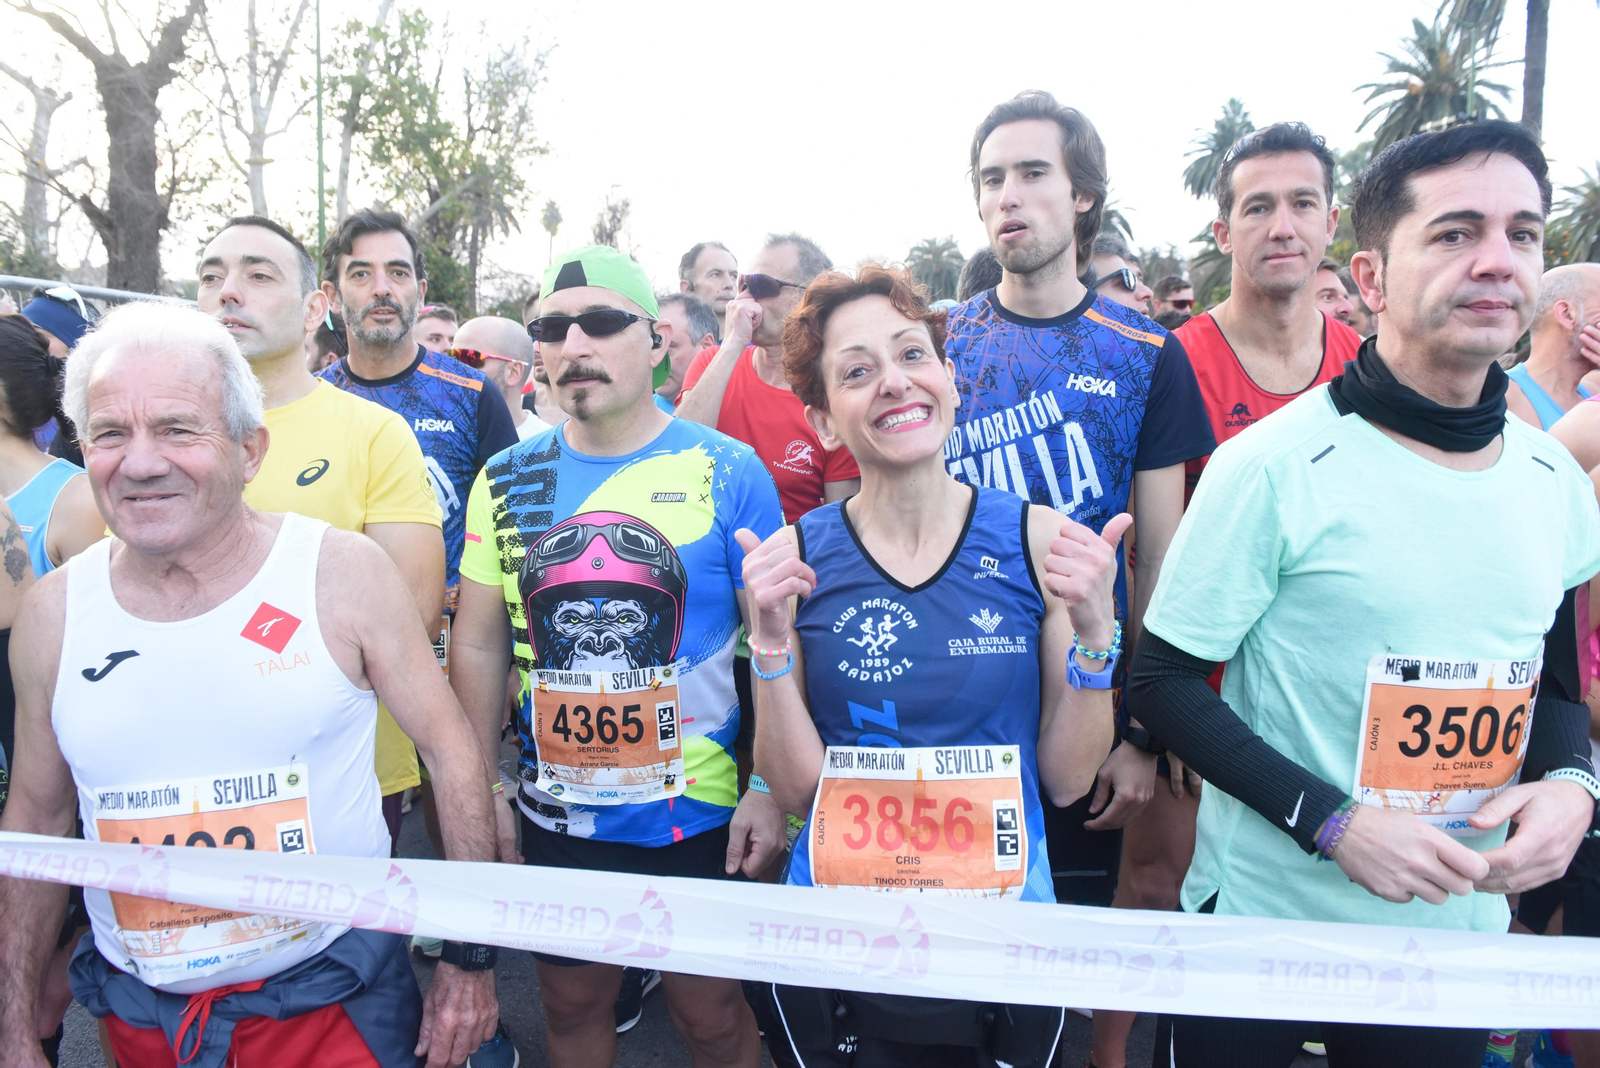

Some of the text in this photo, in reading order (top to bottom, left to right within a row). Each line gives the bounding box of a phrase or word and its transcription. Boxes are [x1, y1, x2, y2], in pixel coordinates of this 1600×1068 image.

[1066, 373, 1117, 398] HOKA
[415, 418, 456, 433] HOKA
[965, 389, 1063, 453] MARATÓN
[832, 598, 918, 634] CLUB MARATON
[948, 636, 1028, 648] CAJA RURAL DE
[949, 645, 1029, 656] EXTREMADURA
[252, 651, 311, 677] TALAI
[838, 657, 913, 683] BADAJOZ
[860, 657, 890, 668] 1989
[1425, 660, 1479, 680] MARATÓN
[558, 671, 592, 687] MARATÓN
[552, 703, 645, 744] 4365
[1398, 703, 1526, 758] 3506
[1369, 723, 1380, 751] CAJÓN
[829, 750, 905, 771] MEDIO MARATÓN
[935, 748, 994, 775] SEVILLA
[1432, 760, 1494, 770] J.L. CHAVES
[98, 784, 180, 810] MEDIO MARATÓN
[212, 772, 277, 806] SEVILLA
[1433, 781, 1486, 790] Chaves Suero
[817, 819, 825, 845] CAJÓN
[842, 794, 975, 853] 3856
[895, 855, 921, 866] CRIS
[874, 877, 944, 887] TINOCO TORRES
[149, 917, 191, 929] Caballero
[186, 955, 221, 970] HOKA
